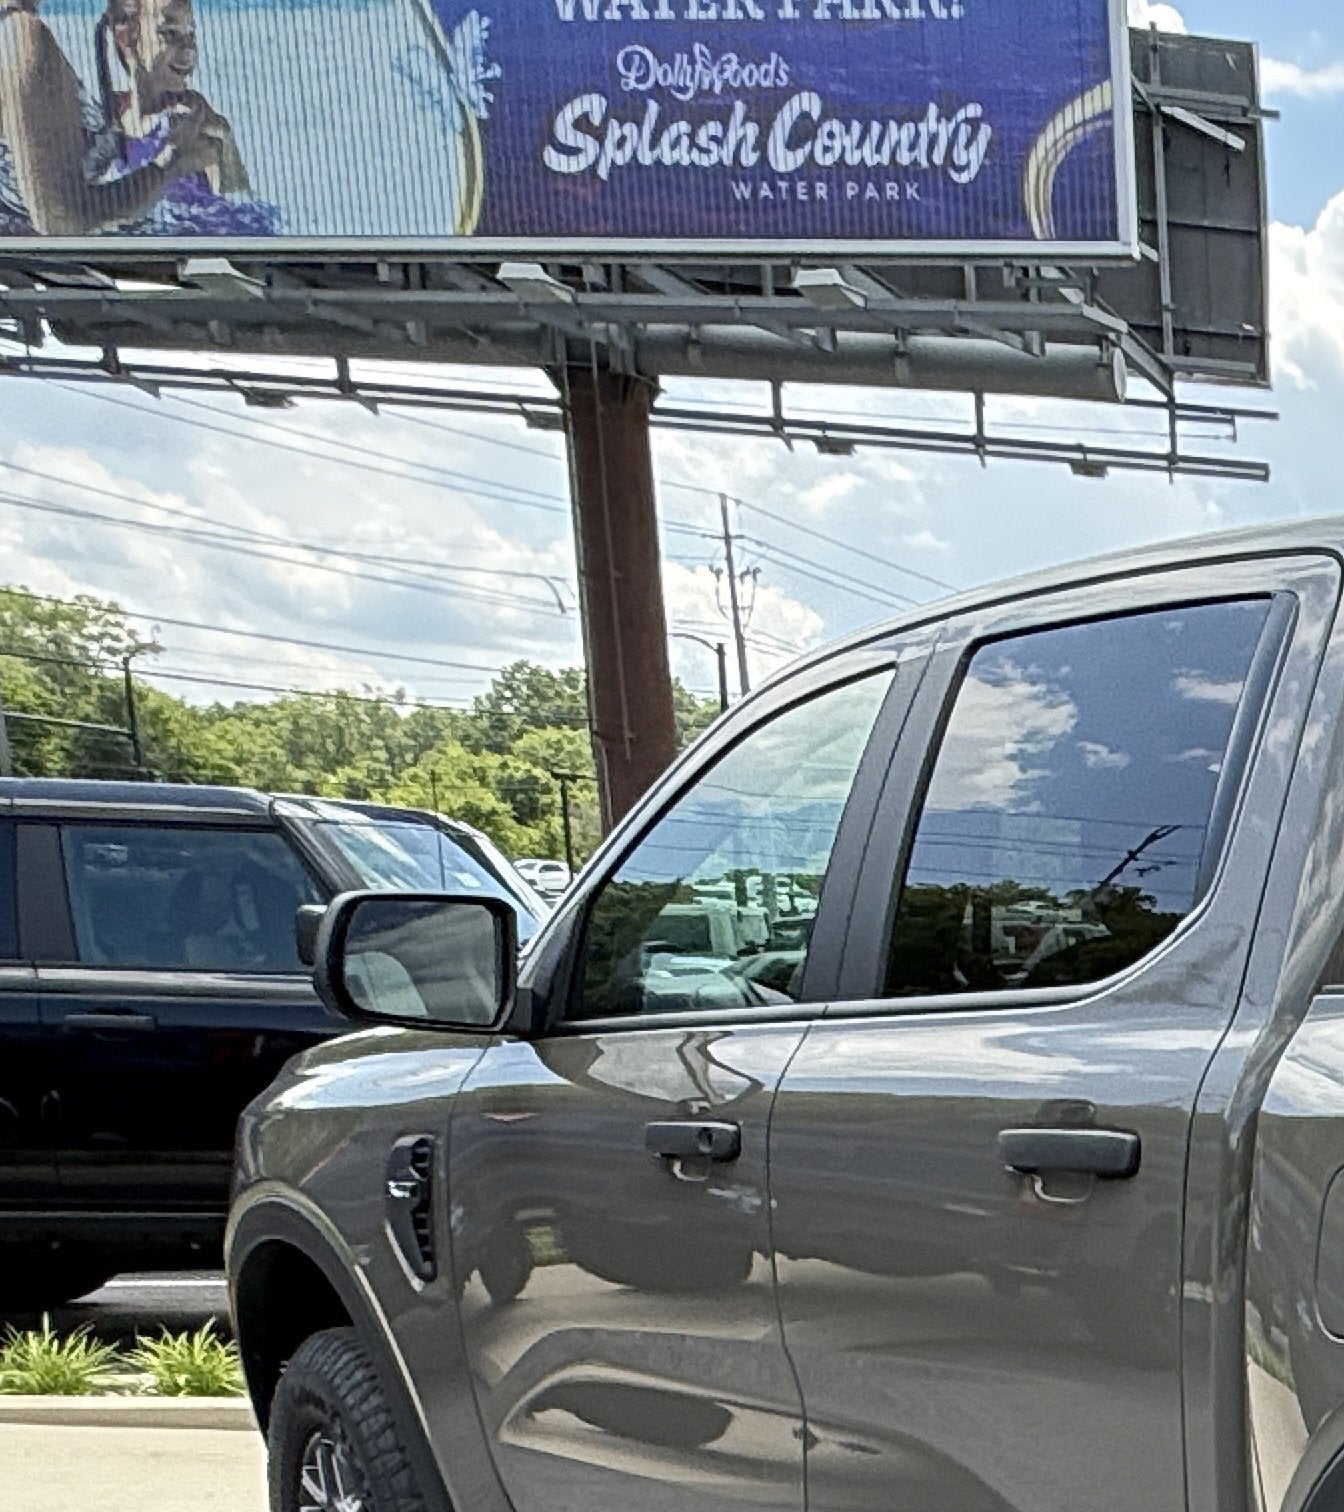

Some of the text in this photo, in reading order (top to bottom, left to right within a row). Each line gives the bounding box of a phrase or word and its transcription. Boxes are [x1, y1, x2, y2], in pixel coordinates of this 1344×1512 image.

[552, 0, 965, 22] WATER PARK!
[542, 91, 992, 184] Splash Country
[732, 181, 921, 201] WATER PARK
